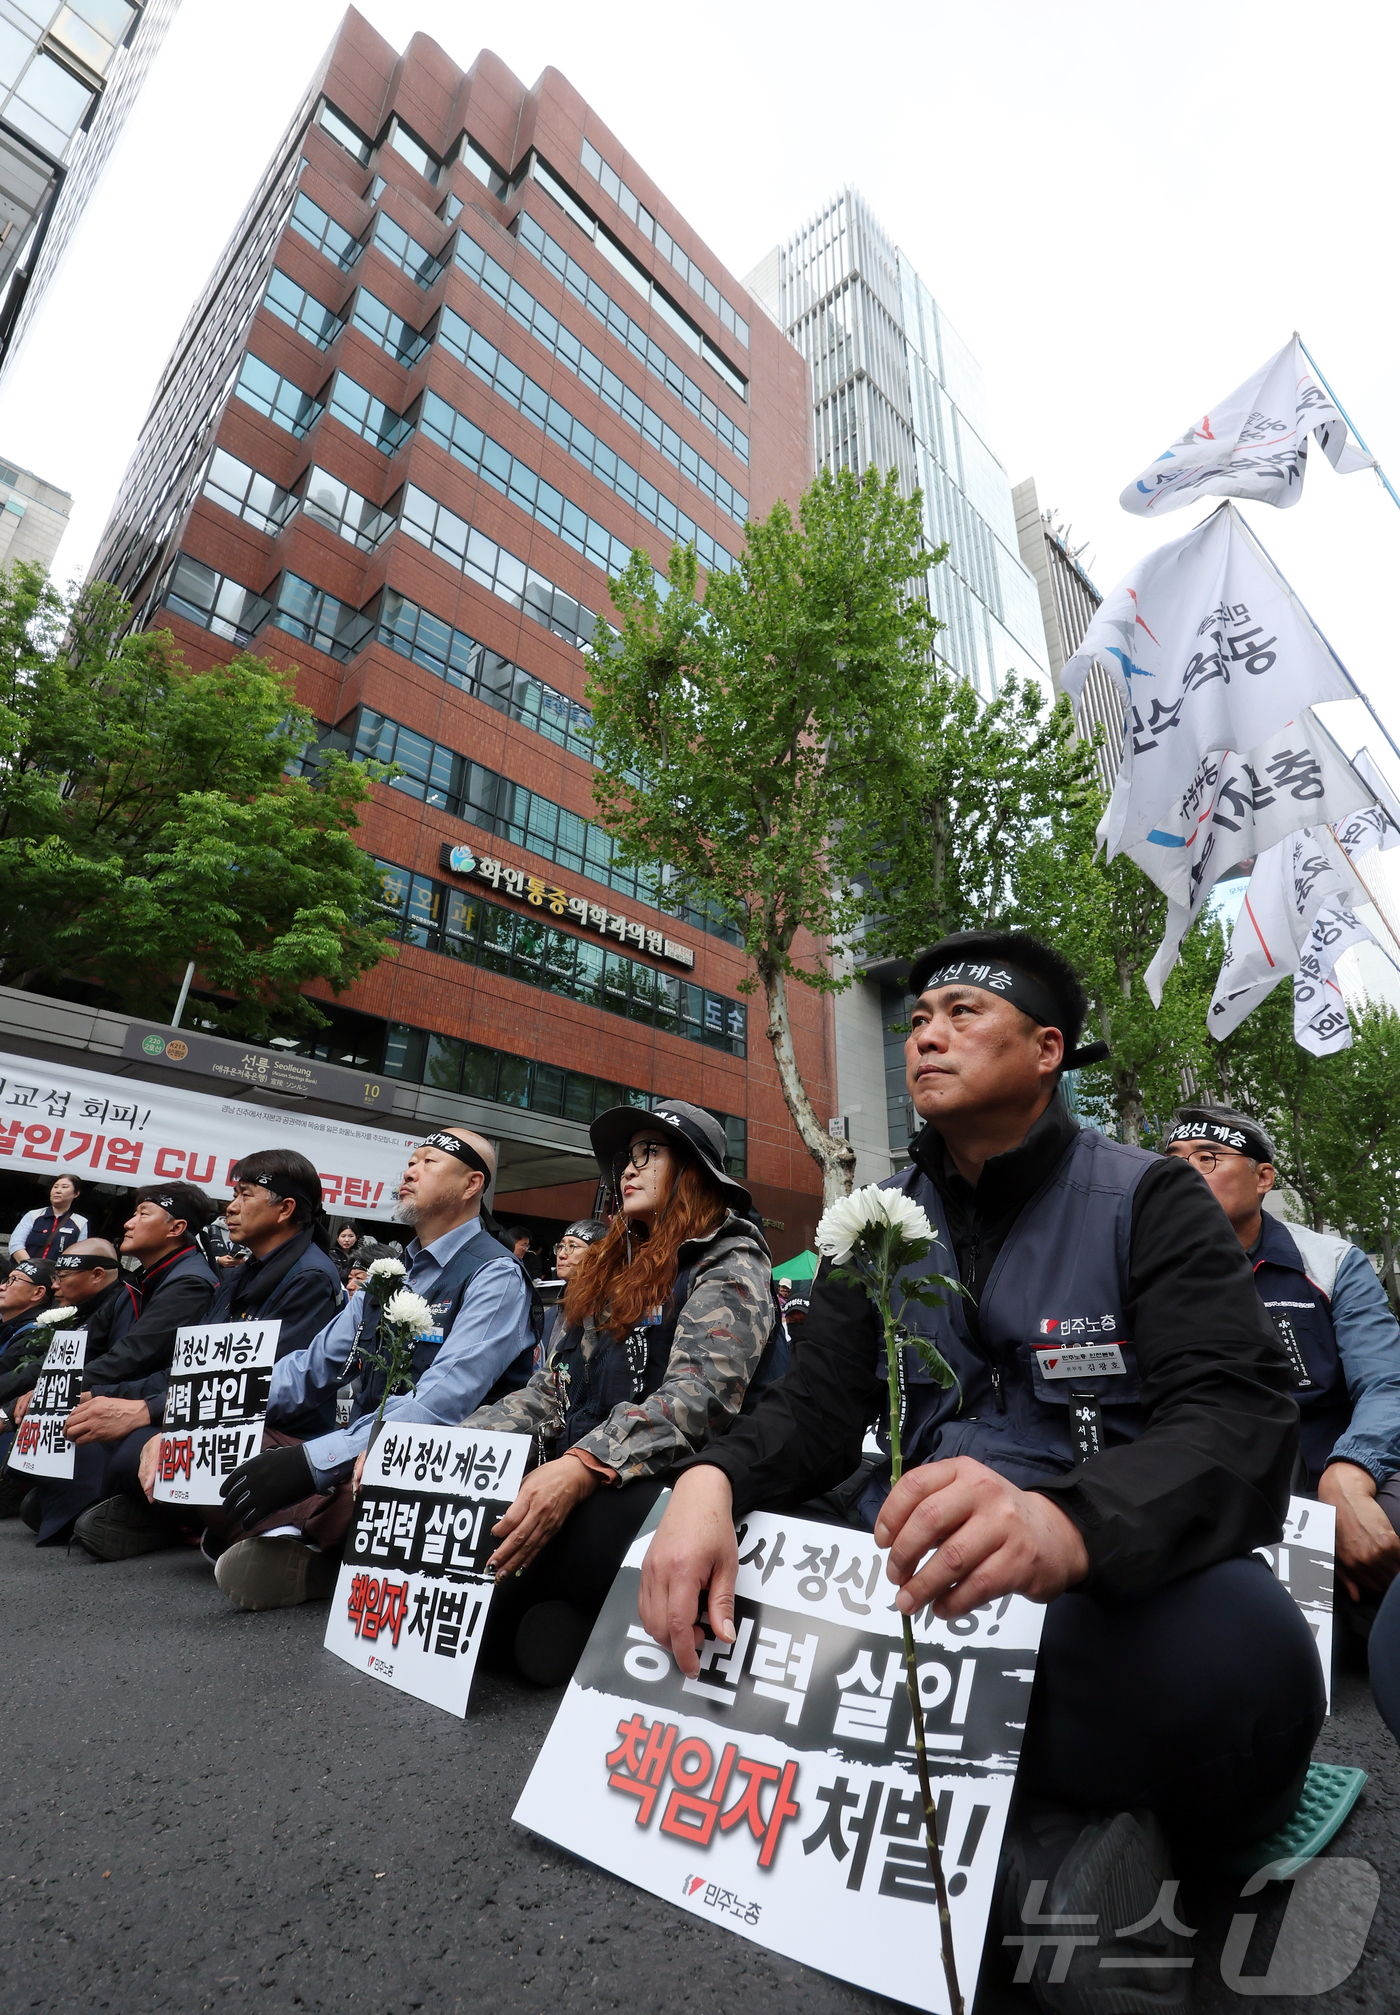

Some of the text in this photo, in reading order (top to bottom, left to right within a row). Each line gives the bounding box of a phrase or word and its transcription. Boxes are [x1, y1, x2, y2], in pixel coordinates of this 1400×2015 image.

[477, 856, 664, 957] 화인통증의학과의원
[966, 963, 1013, 990] 계승
[144, 1043, 162, 1053] 2호선
[149, 1037, 161, 1045] 220
[169, 1042, 186, 1051] K215
[241, 1054, 270, 1074] 선릉
[273, 1061, 312, 1077] Seolleung
[364, 1083, 380, 1098] 10
[79, 1097, 151, 1131] 회피!
[436, 1132, 462, 1152] 계승
[1177, 1121, 1208, 1139] 정신
[1210, 1124, 1247, 1148] 계승
[0, 1118, 144, 1174] 살인기업
[154, 1147, 217, 1183] CU
[318, 1173, 384, 1209] 규탄!
[1060, 1314, 1117, 1336] 민주노총
[58, 1340, 80, 1365] 계승!
[182, 1335, 209, 1367] 정신
[212, 1331, 265, 1364] 계승!
[1061, 1353, 1086, 1361] 민주노총
[45, 1373, 71, 1409] 살인
[197, 1373, 249, 1421] 살인
[196, 1431, 257, 1477] 처벌!
[381, 1434, 512, 1491] 열사 정신 계승!
[354, 1500, 486, 1567] 공권력 살인
[735, 1523, 785, 1586] 사
[793, 1543, 883, 1616] 정신
[347, 1573, 483, 1659] 책임자 처벌!
[374, 1660, 394, 1678] 민주노총
[832, 1649, 978, 1752] 살인
[606, 1713, 992, 1905] 책임자 처벌!
[703, 1883, 763, 1927] 민주노총
